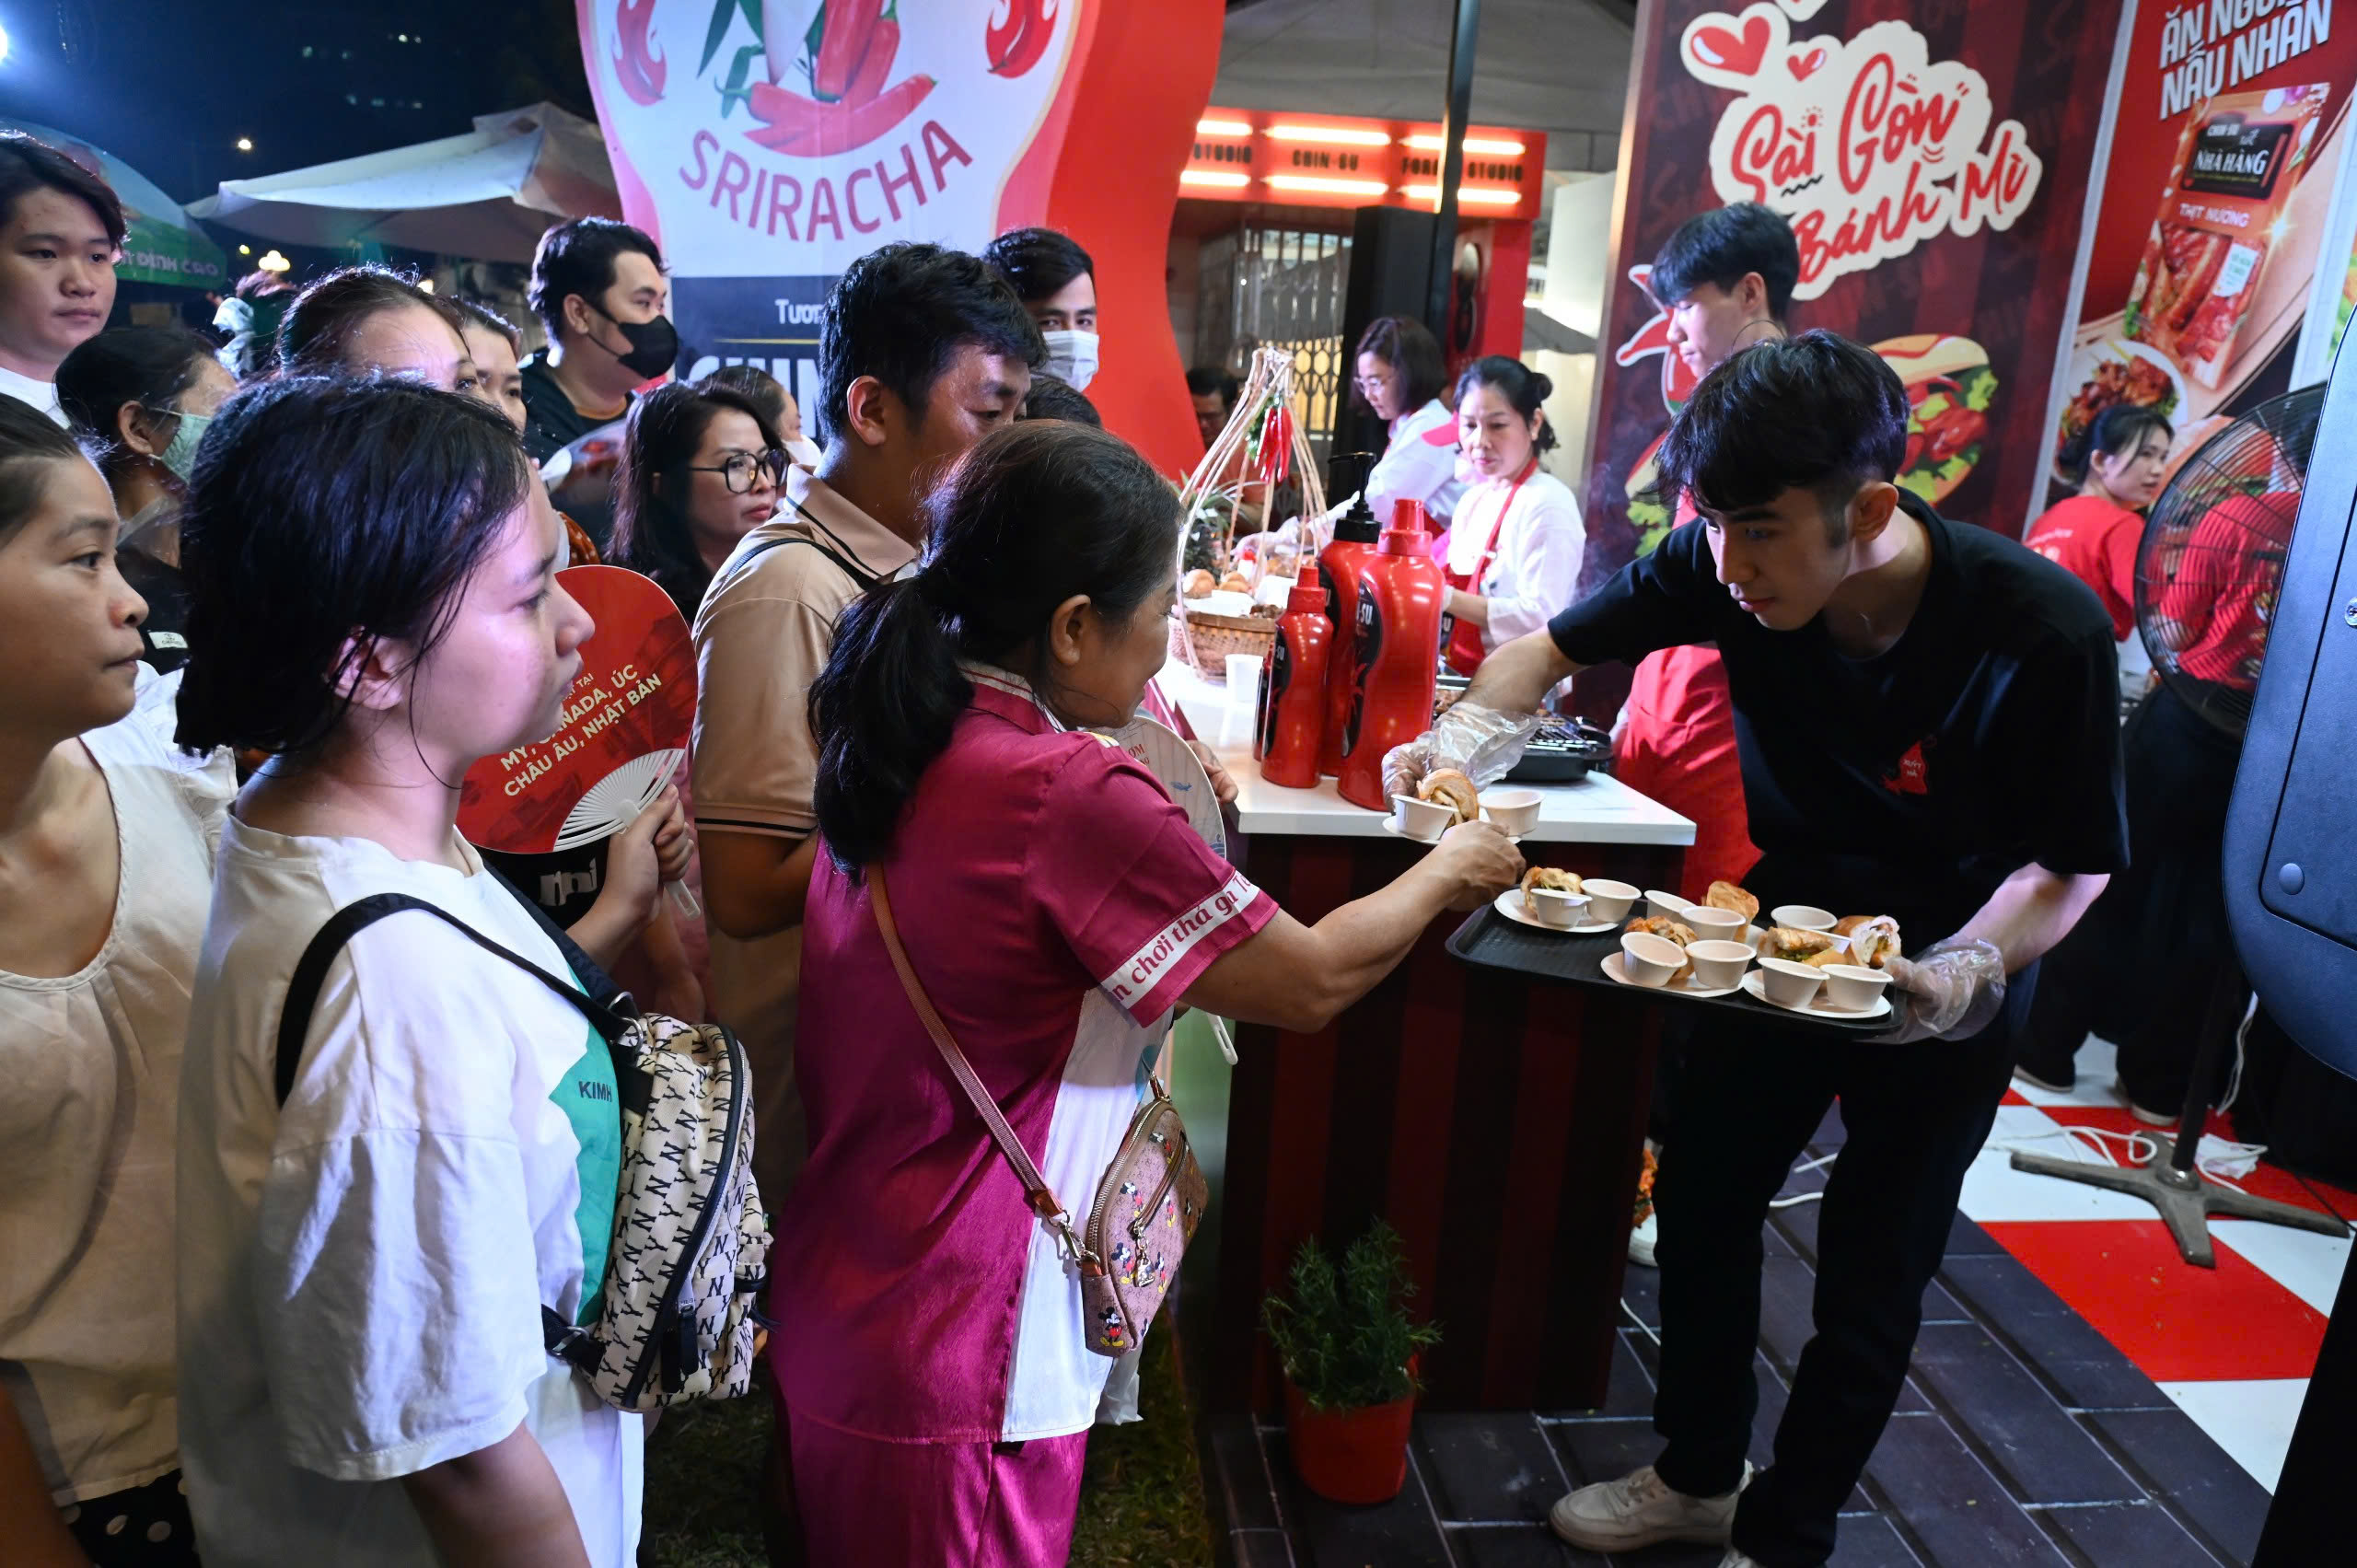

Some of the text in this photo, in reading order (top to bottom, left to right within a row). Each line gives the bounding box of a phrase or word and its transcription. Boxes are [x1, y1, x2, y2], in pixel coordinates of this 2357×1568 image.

[679, 120, 972, 242] SRIRACHA
[611, 665, 638, 689] ÚC
[505, 754, 552, 796] CHÂU
[582, 698, 626, 738] NHẬT
[626, 673, 662, 706] BẢN
[1131, 935, 1175, 984] chơi
